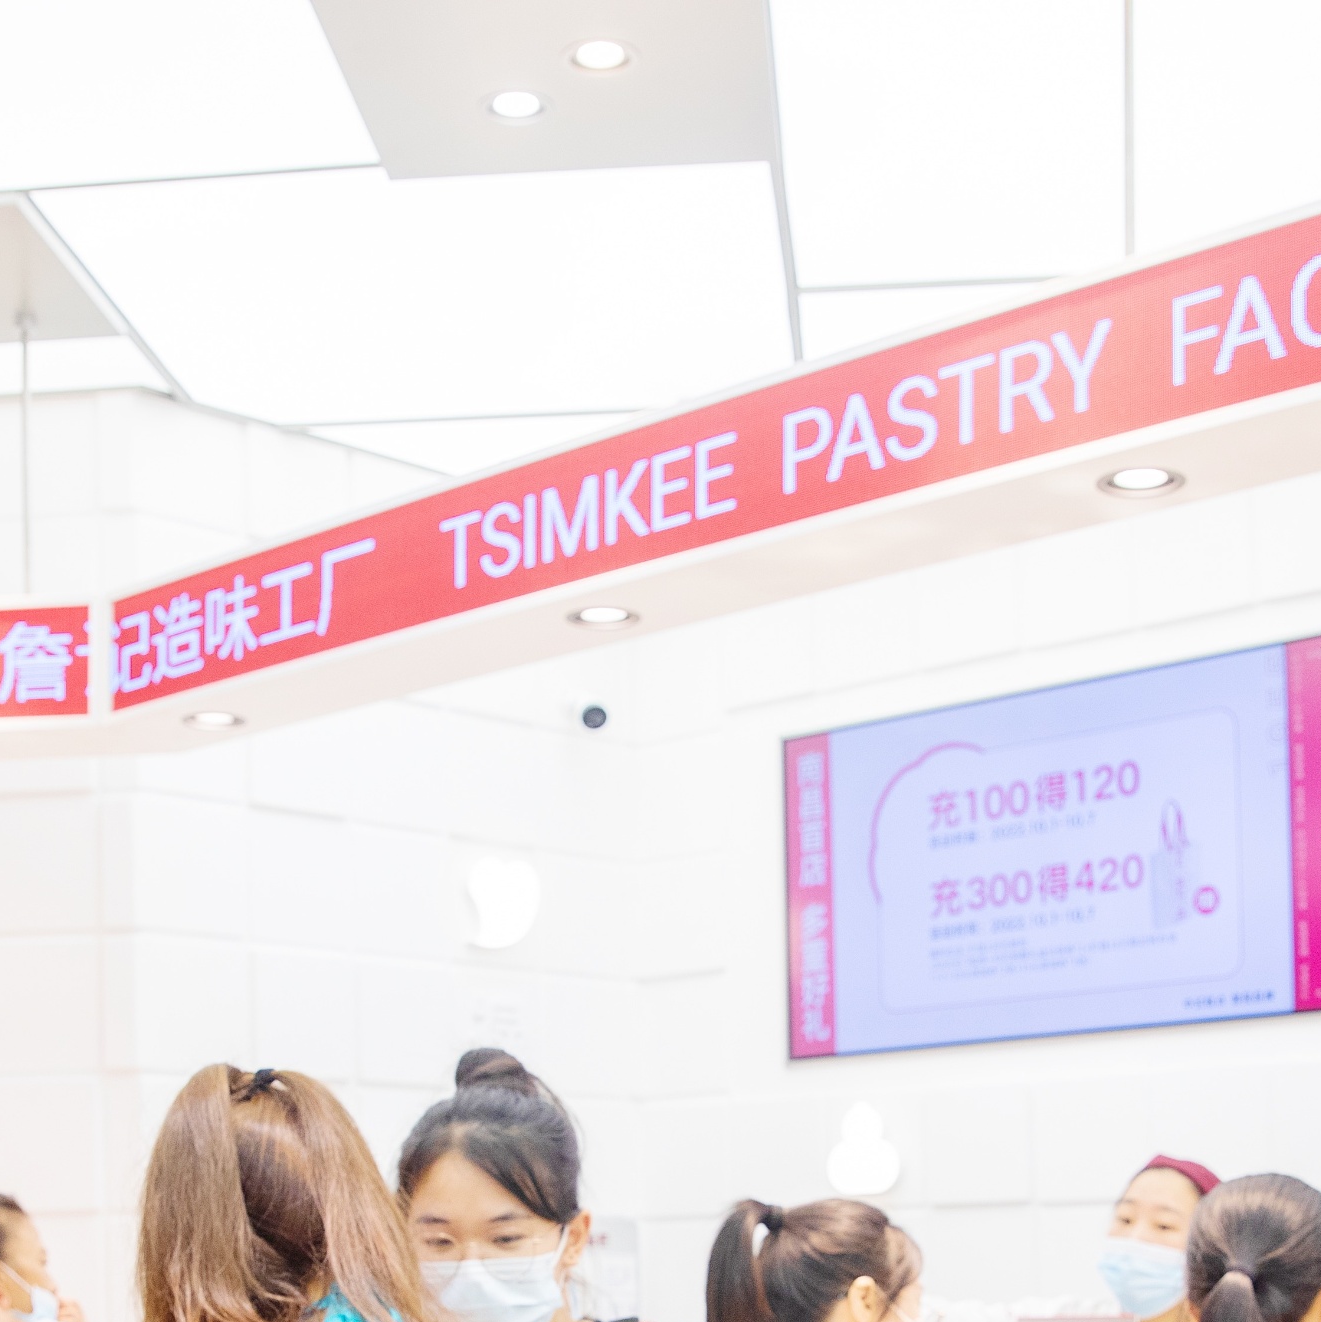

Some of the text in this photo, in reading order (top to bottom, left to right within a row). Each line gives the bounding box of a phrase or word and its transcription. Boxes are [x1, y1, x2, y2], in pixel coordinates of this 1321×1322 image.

[439, 432, 739, 590] TSIMKEE
[781, 319, 1113, 496] PASTRY
[928, 760, 1140, 832] 充100得120
[930, 852, 1144, 920] 充300得420
